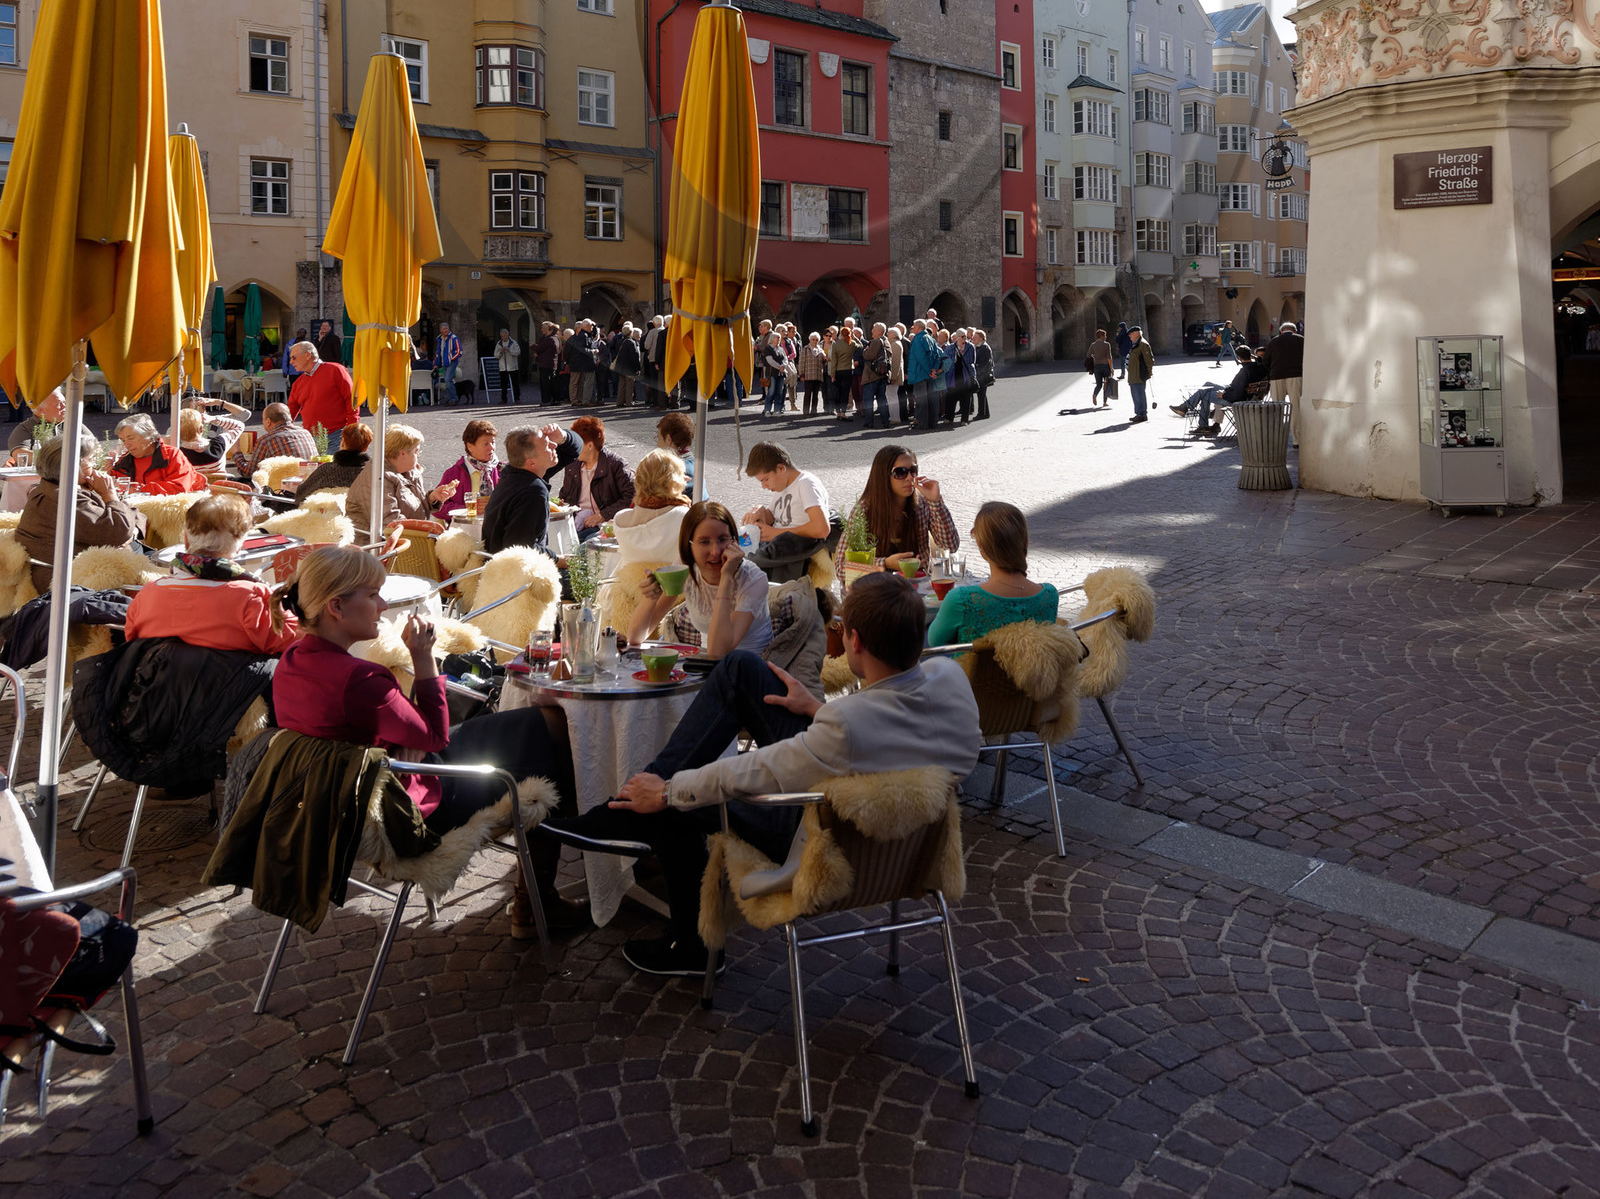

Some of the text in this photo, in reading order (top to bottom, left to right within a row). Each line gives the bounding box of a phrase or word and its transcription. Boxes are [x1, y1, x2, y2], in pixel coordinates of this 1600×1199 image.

[1438, 153, 1483, 164] Herzog-
[1428, 165, 1483, 178] Friedrich-
[1438, 177, 1478, 190] Straße
